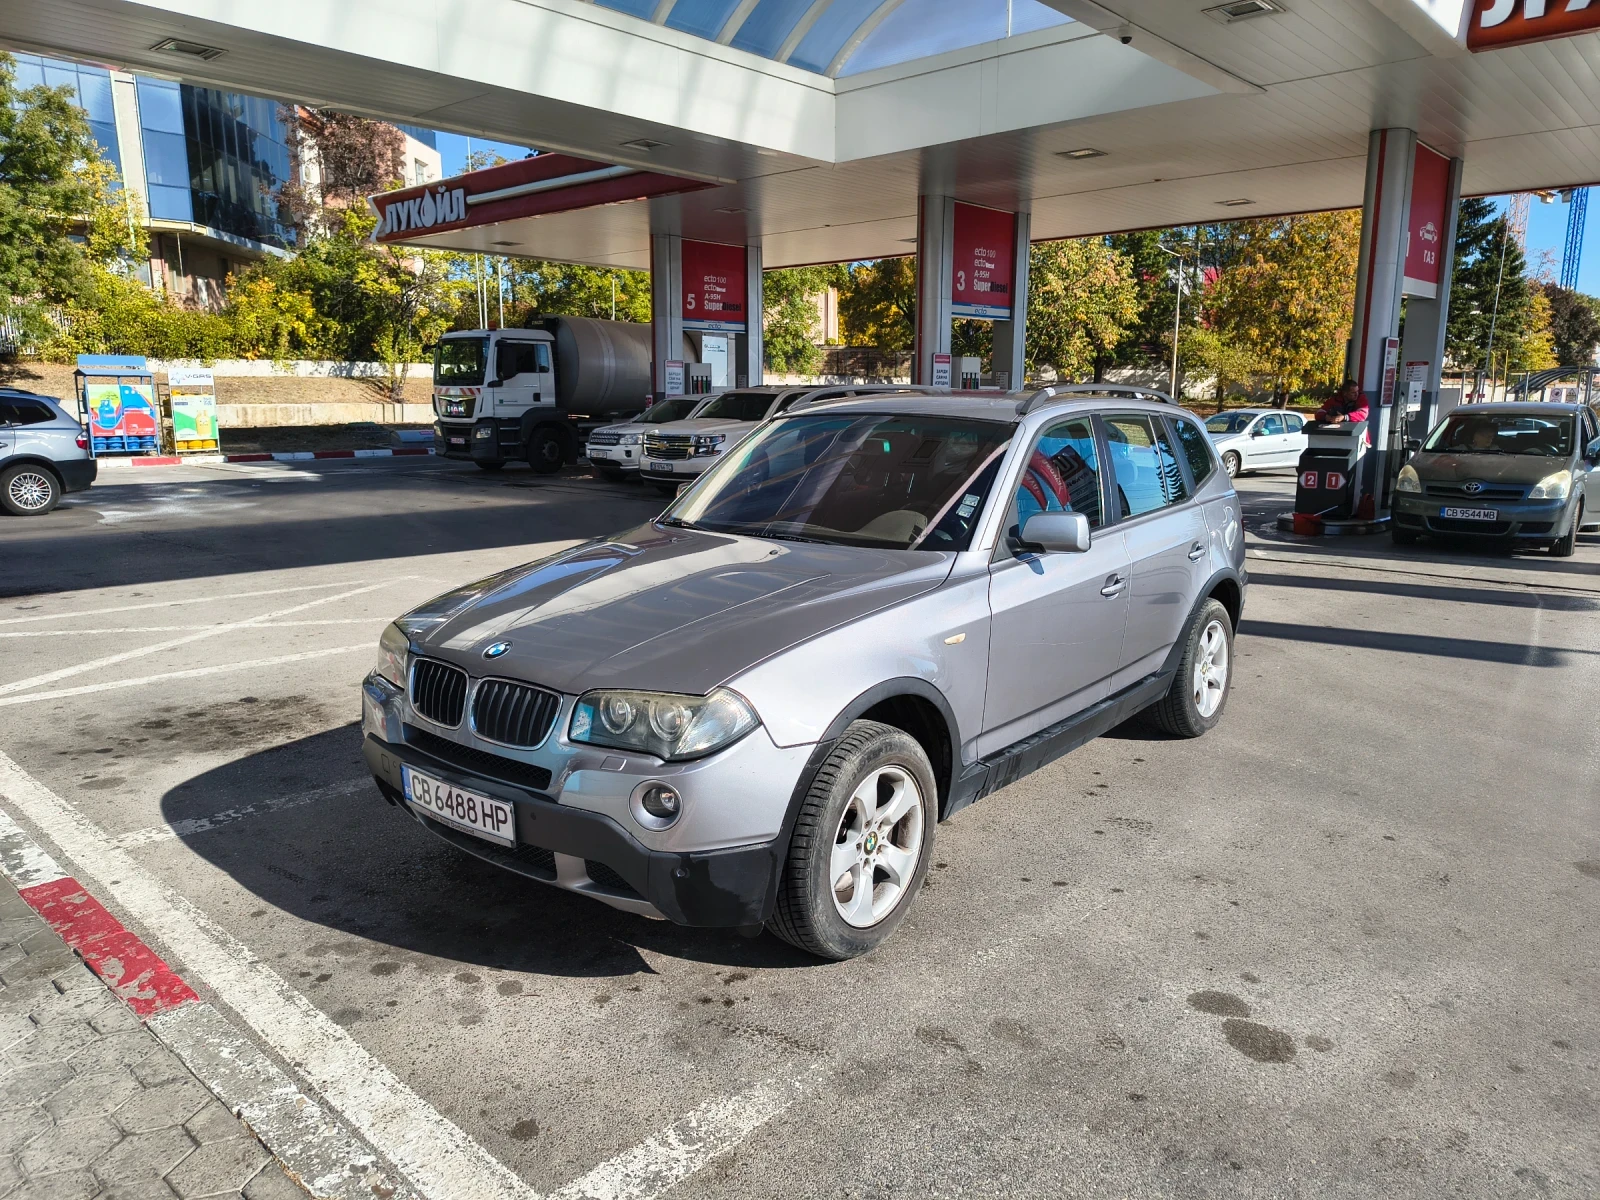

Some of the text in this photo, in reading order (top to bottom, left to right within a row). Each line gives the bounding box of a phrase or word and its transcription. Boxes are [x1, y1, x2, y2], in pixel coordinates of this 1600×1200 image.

[385, 185, 466, 234] ЛУКОЙЛ
[974, 247, 986, 257] ecto
[1423, 249, 1435, 265] ГАЗ
[704, 274, 727, 284] ecto 100
[957, 270, 966, 291] 3
[686, 293, 696, 310] 5
[1307, 475, 1315, 485] 2
[1331, 476, 1336, 486] 1
[1446, 508, 1496, 520] CB 9544 MB
[411, 774, 508, 832] CB 6488 HP
